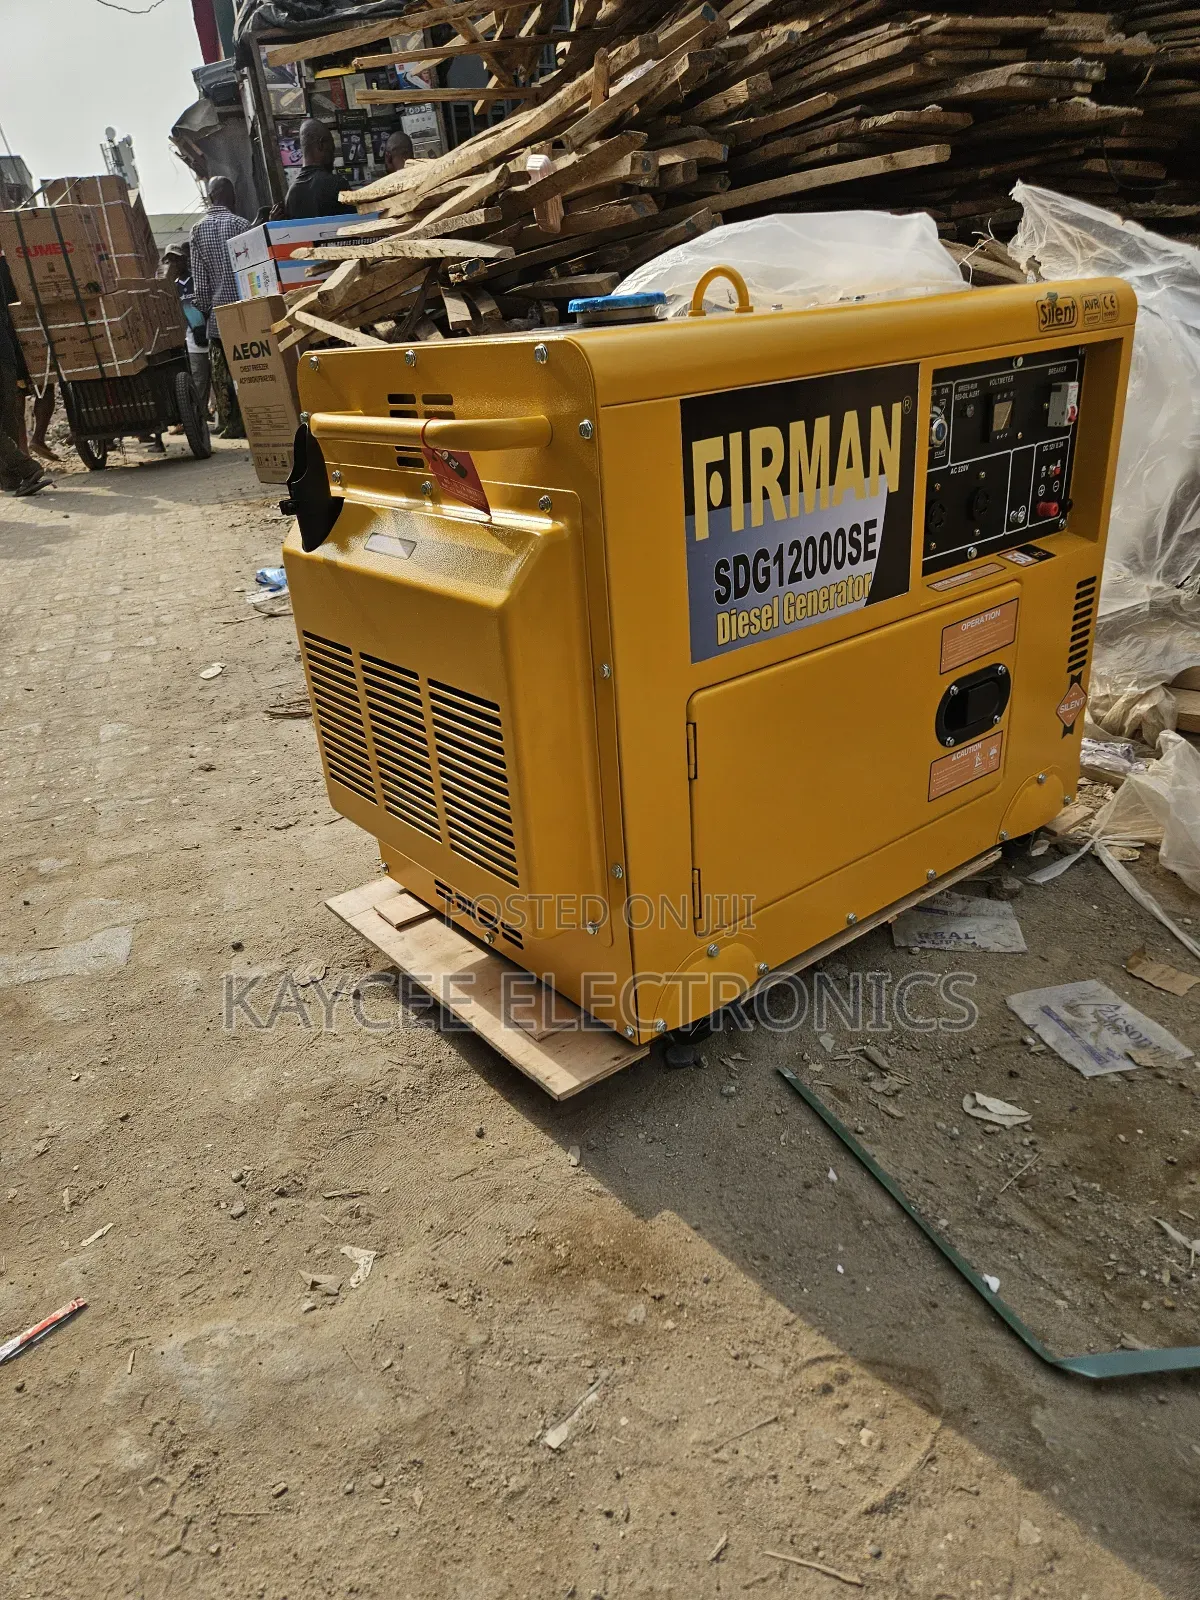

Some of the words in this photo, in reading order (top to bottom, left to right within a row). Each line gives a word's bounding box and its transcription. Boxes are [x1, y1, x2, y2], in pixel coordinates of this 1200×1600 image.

[1040, 300, 1076, 325] Silent
[1084, 298, 1100, 311] AVR
[232, 340, 272, 361] AEON
[1048, 365, 1067, 376] BREAKER
[989, 375, 1014, 387] VOLTMETER
[691, 401, 902, 542] FIRMAN
[950, 466, 959, 475] AC
[713, 518, 878, 605] SDG12000SE
[716, 596, 780, 646] Diesel
[783, 572, 873, 627] Generator
[961, 609, 1001, 631] OPERATION
[1059, 697, 1085, 714] SILENT
[956, 742, 982, 760] CAUTION
